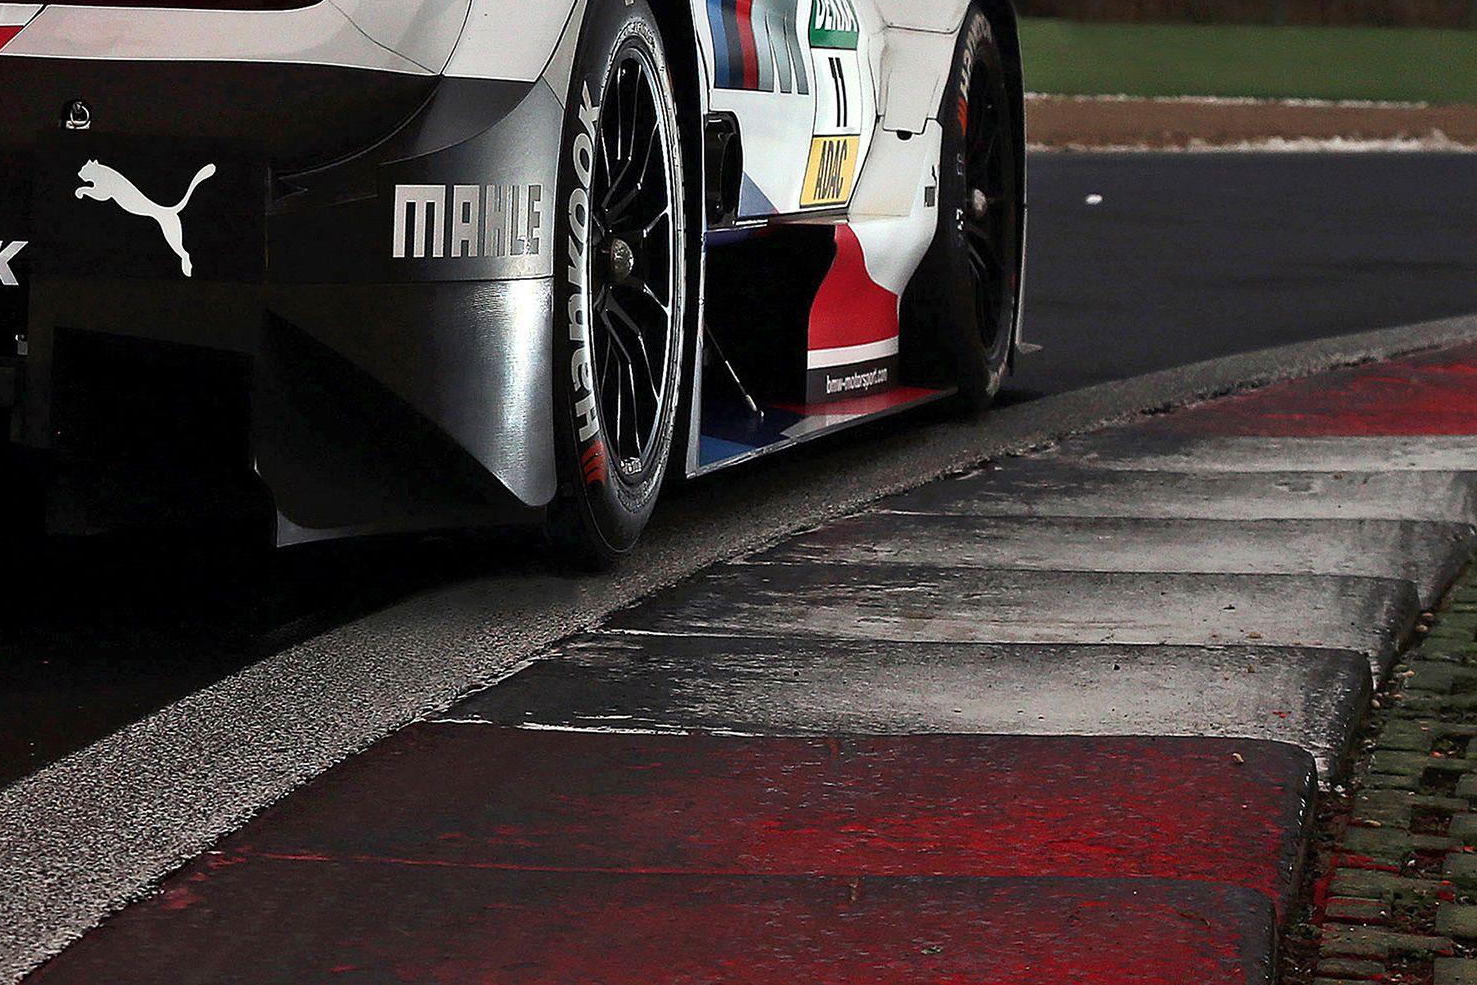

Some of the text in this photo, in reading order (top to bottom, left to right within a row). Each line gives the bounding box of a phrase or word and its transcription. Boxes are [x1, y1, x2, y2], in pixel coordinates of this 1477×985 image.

[828, 57, 848, 127] 11
[813, 139, 847, 201] ADAC
[392, 184, 543, 258] MAHLE
